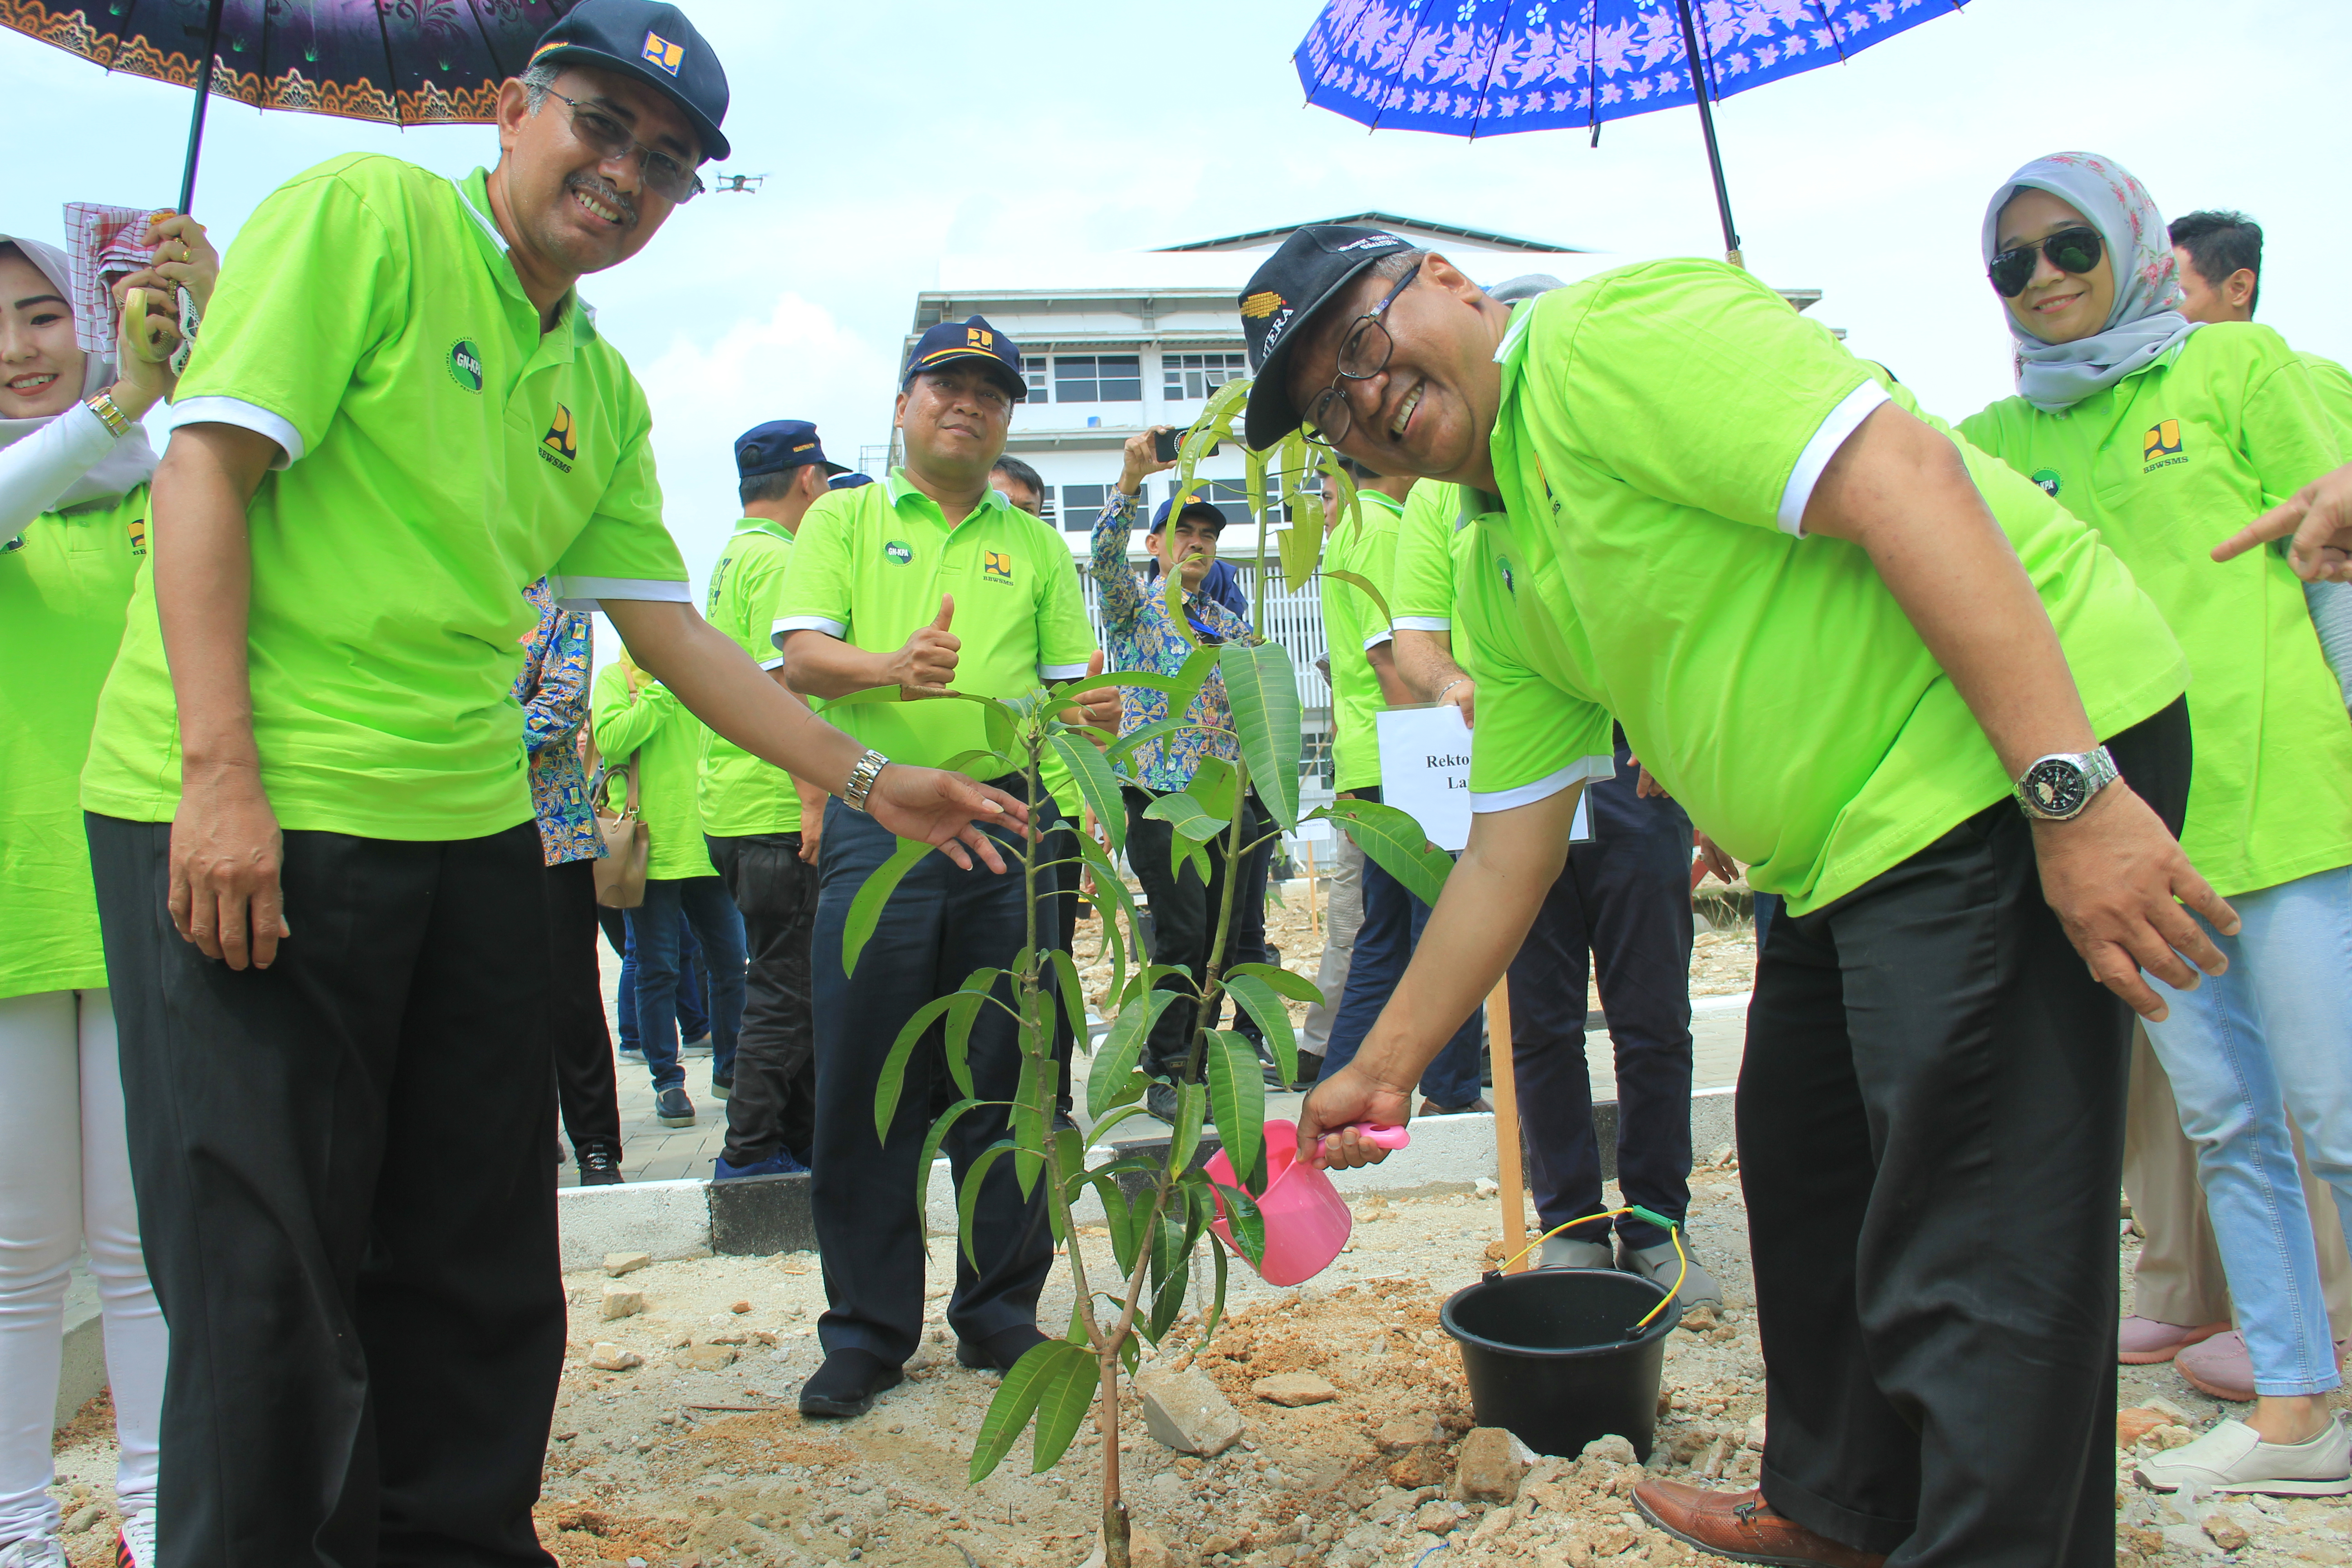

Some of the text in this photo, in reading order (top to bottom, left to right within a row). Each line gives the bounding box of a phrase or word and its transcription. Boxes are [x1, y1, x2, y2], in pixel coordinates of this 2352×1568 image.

[539, 446, 572, 473] BBWSMS
[2142, 456, 2189, 474] BBWSMS
[888, 547, 909, 557] GN-KPA
[983, 575, 1014, 586] BBWSMS
[1426, 754, 1472, 768] Rekto
[1446, 776, 1470, 789] La
